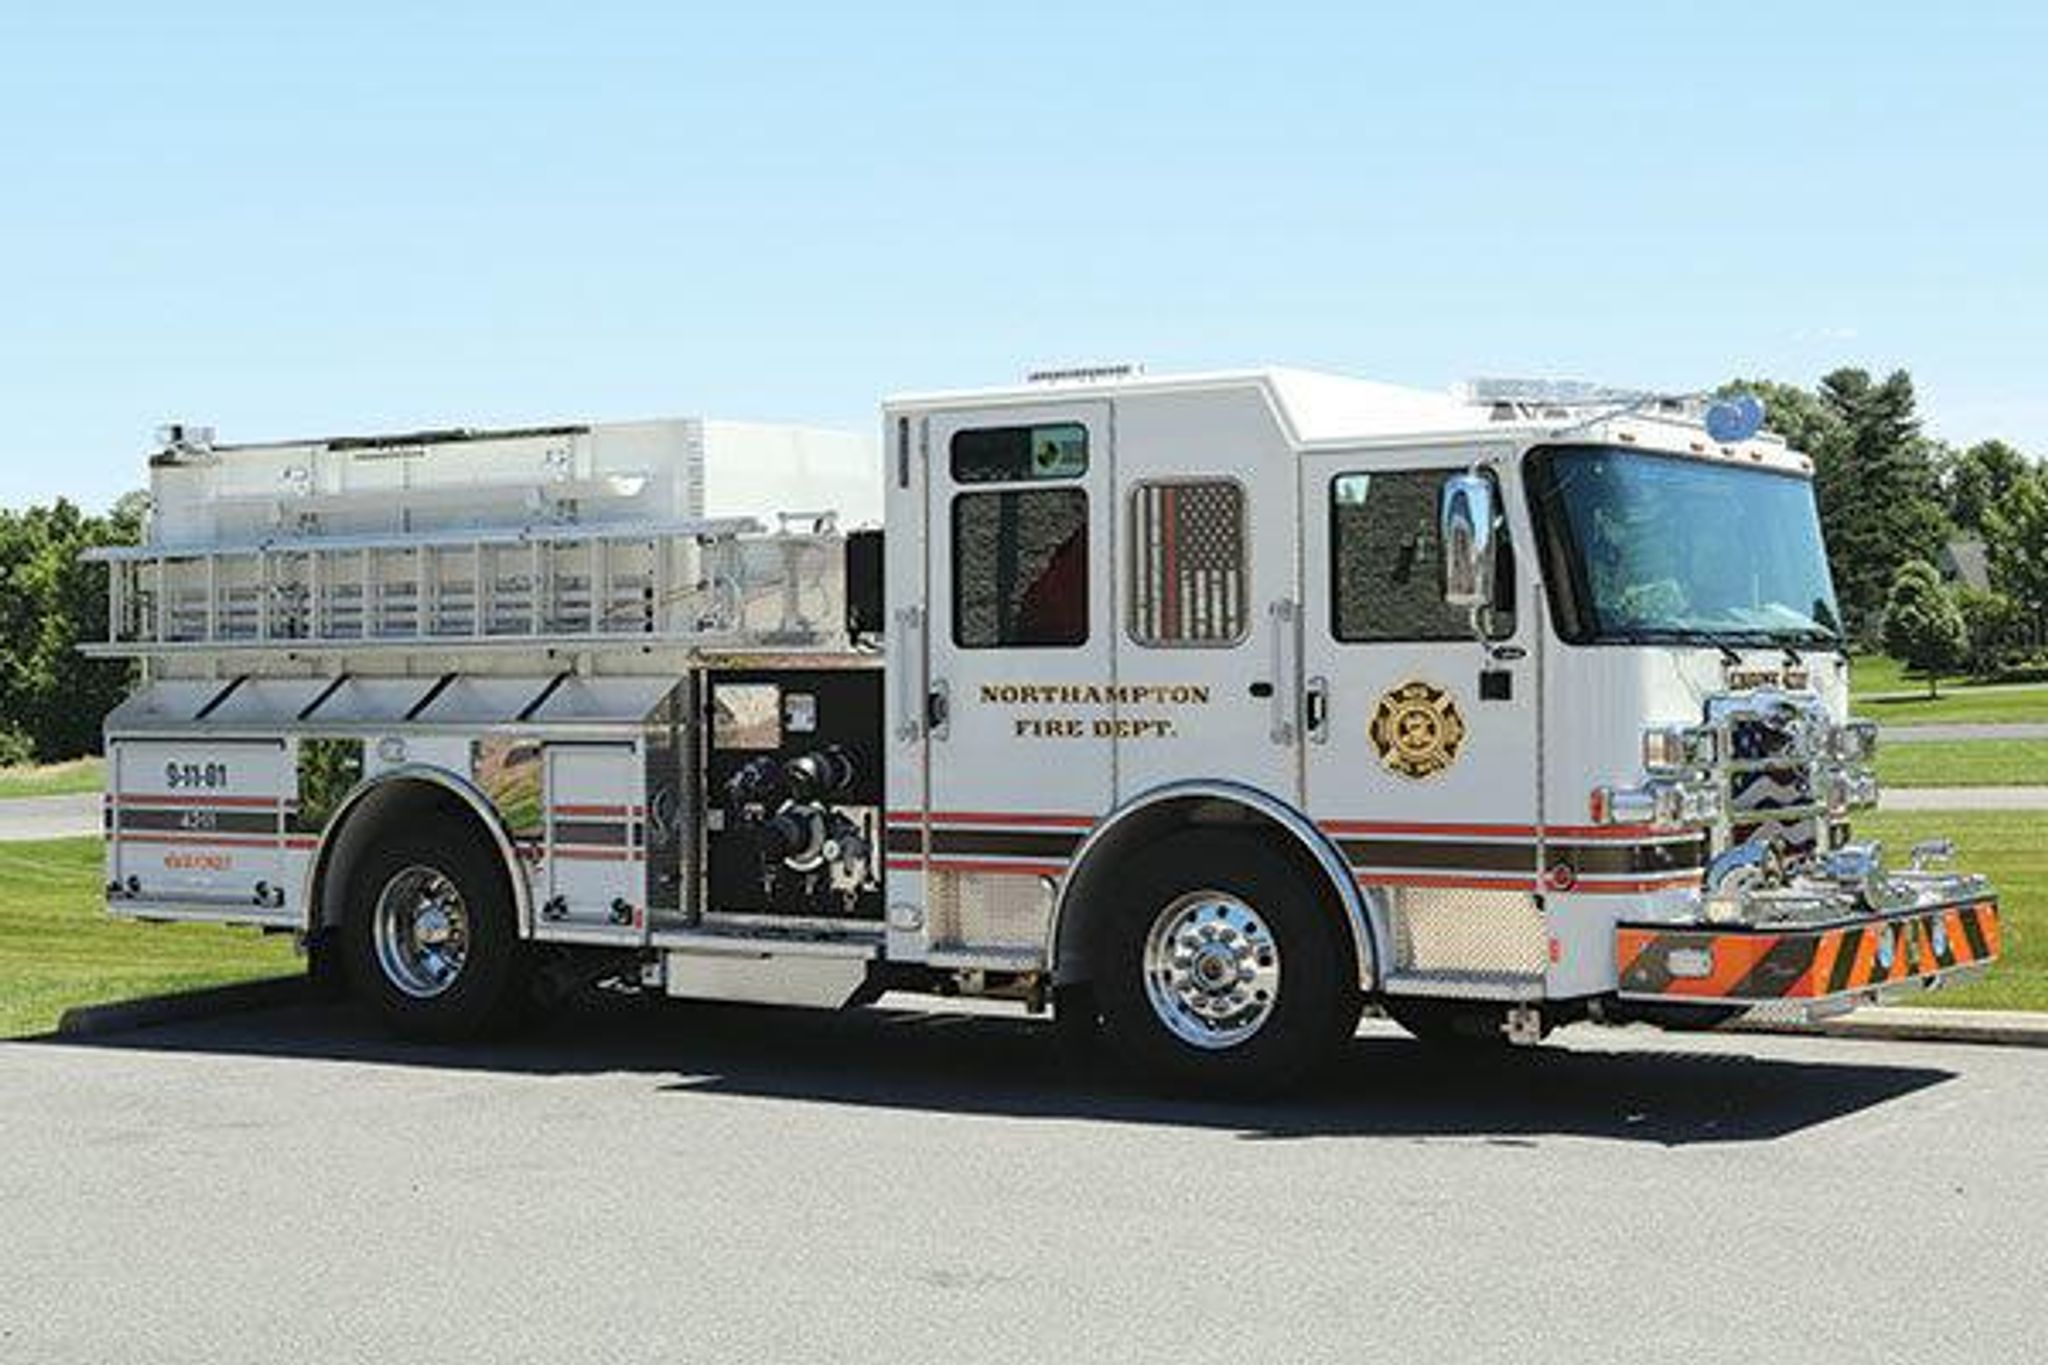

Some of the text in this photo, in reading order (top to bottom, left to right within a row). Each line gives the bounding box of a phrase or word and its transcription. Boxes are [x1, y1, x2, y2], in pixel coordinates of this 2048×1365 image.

[979, 685, 1210, 704] NORTHAMPTON
[1014, 719, 1178, 738] FIRE DEPT.
[166, 762, 227, 789] 9-11-01
